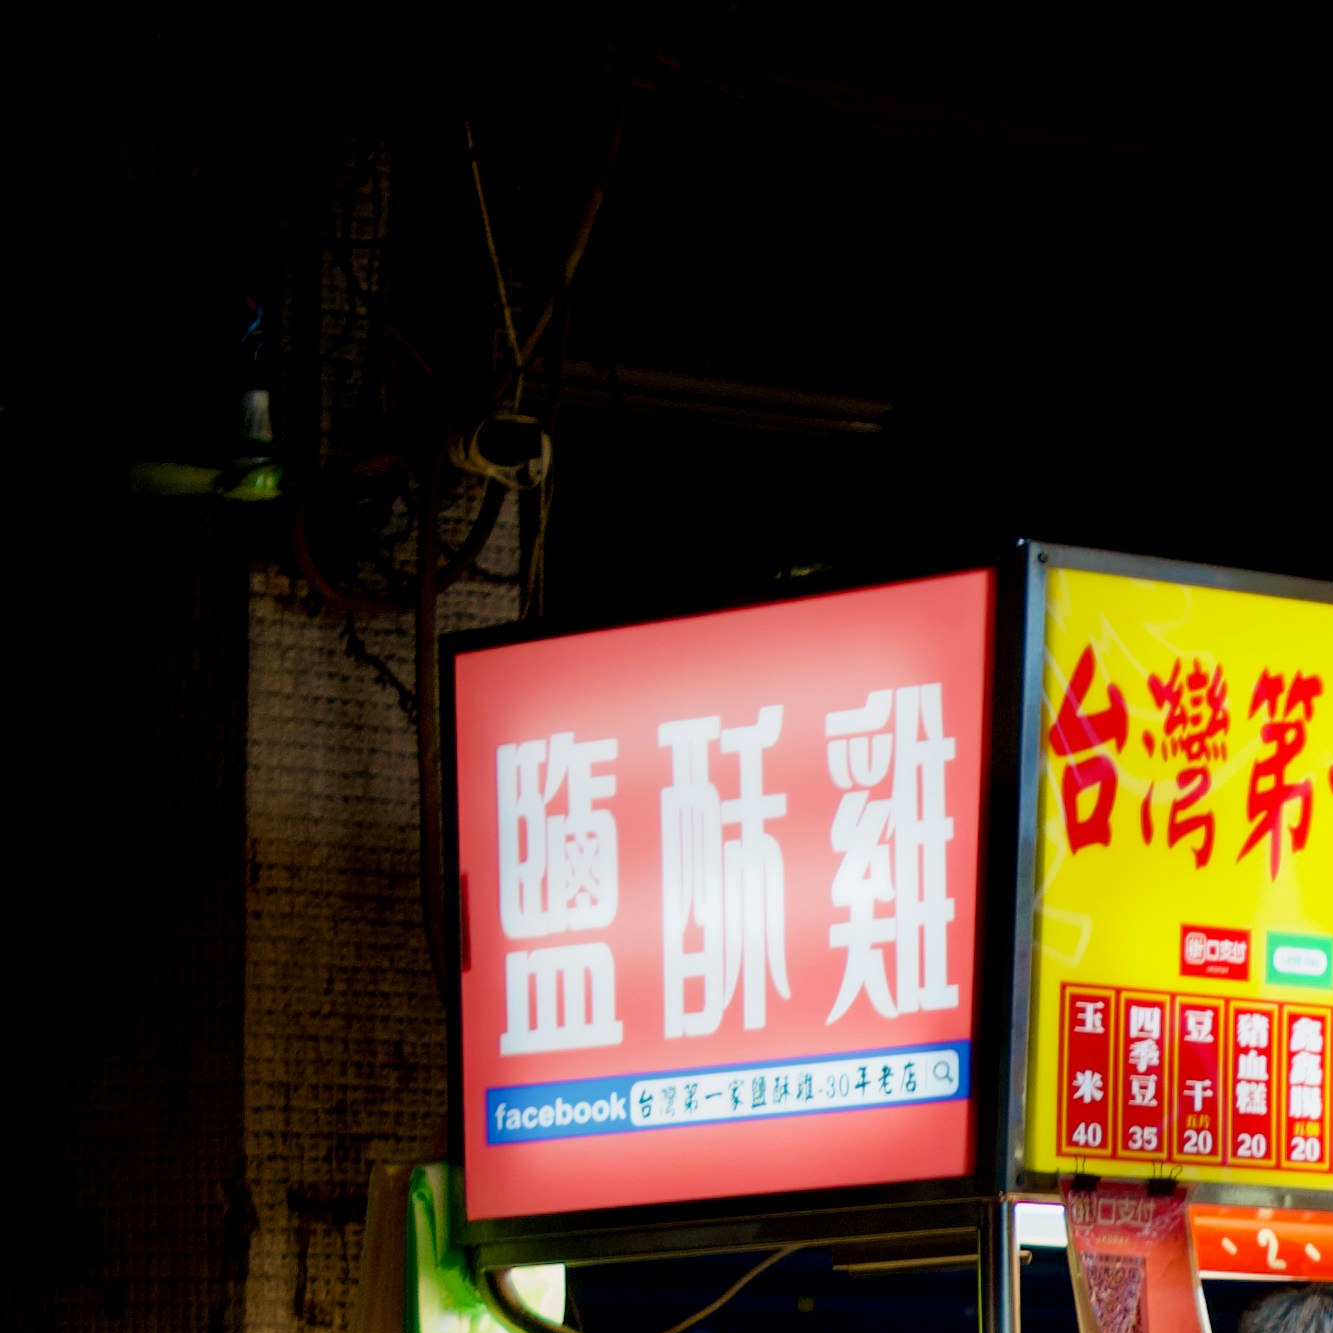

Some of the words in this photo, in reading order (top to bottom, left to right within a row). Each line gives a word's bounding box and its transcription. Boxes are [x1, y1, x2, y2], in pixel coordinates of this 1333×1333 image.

[496, 682, 960, 1057] 鹽酥雞
[1074, 1001, 1105, 1103] 玉米
[1129, 1005, 1161, 1106] 四季豆
[1184, 1009, 1214, 1111] 豆干
[494, 1091, 627, 1132] facebook
[1072, 1122, 1102, 1146] 40
[1129, 1126, 1158, 1150] 35
[1183, 1129, 1213, 1154] 20
[1237, 1133, 1267, 1158] 20
[1290, 1136, 1321, 1162] 20
